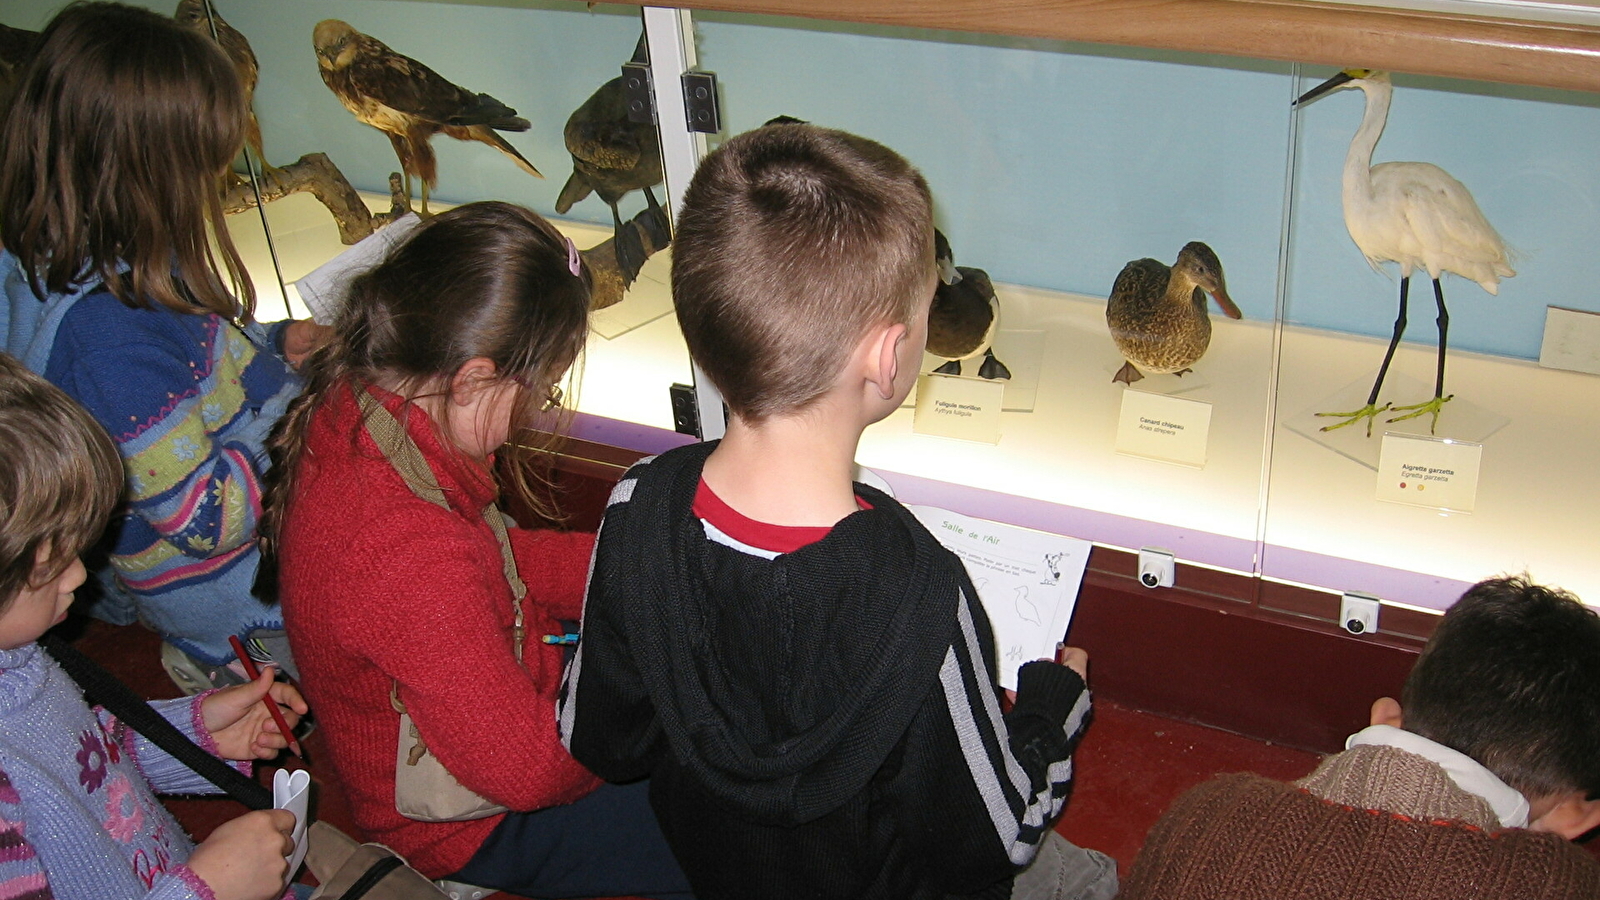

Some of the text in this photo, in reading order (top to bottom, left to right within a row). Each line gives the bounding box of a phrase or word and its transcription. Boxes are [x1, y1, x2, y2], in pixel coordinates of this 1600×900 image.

[935, 400, 957, 408] Fuligule
[1140, 417, 1184, 430] Canard chipeau
[1401, 471, 1422, 479] Egretta
[1402, 464, 1454, 476] Aigrette garzette
[941, 520, 964, 535] Salle
[968, 531, 979, 540] de
